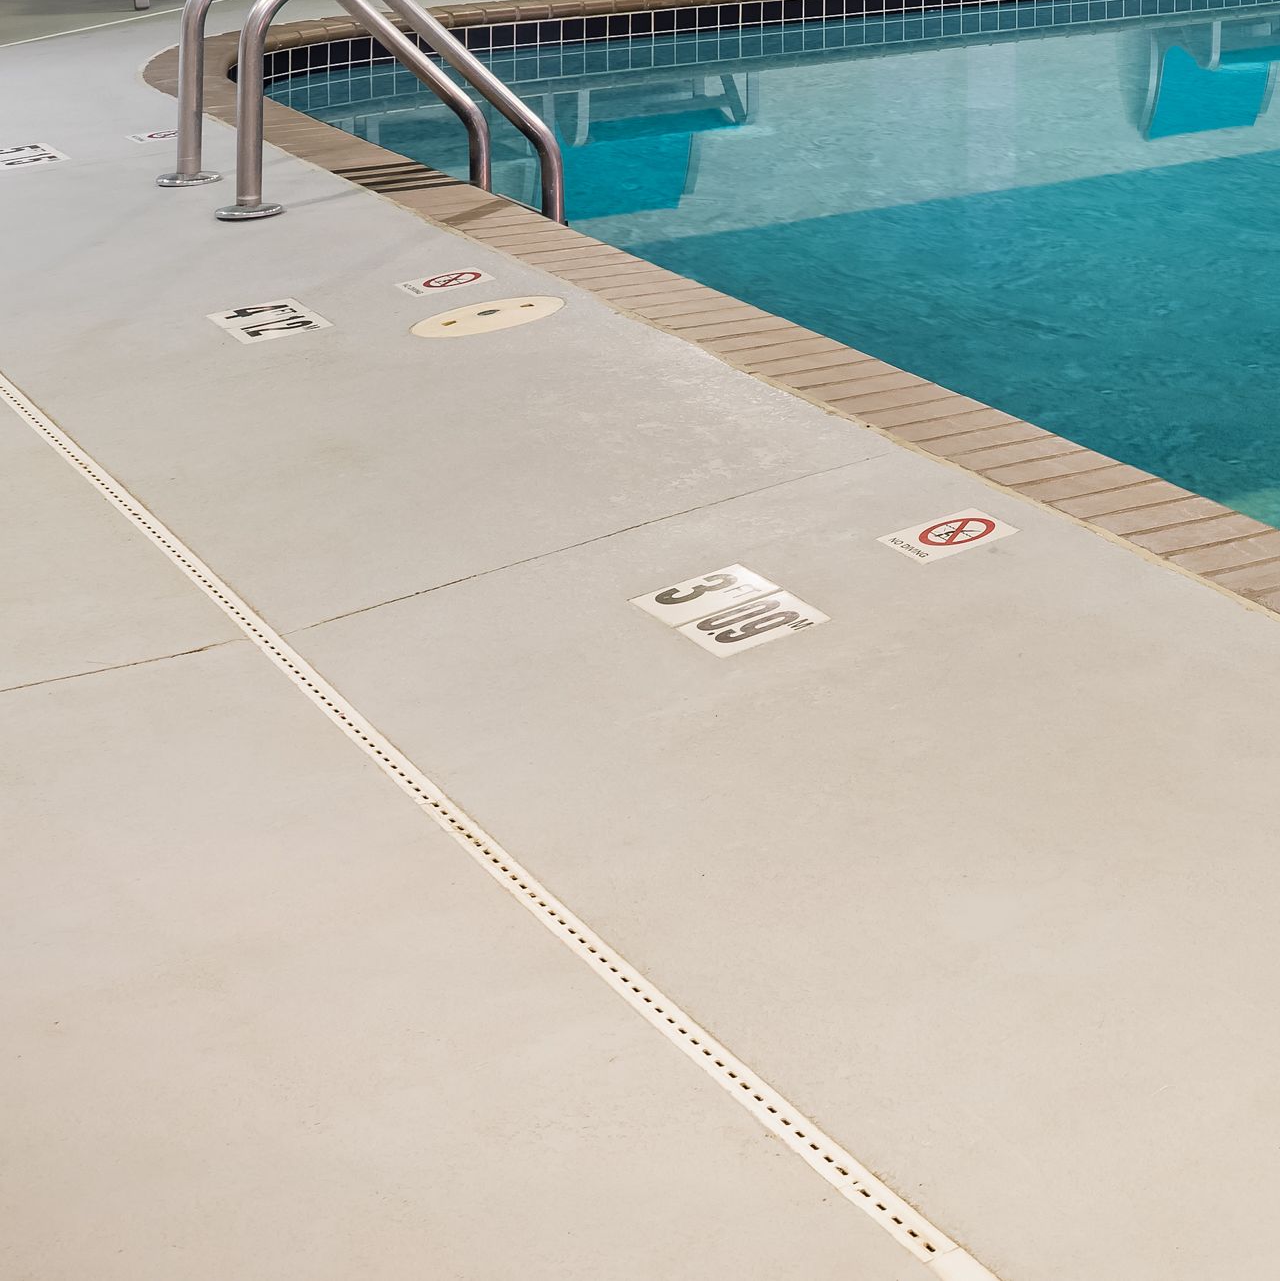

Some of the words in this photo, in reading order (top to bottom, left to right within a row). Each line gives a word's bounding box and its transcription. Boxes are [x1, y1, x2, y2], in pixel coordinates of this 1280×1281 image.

[224, 304, 289, 319] 4
[888, 537, 904, 545] NO
[655, 573, 738, 605] 3
